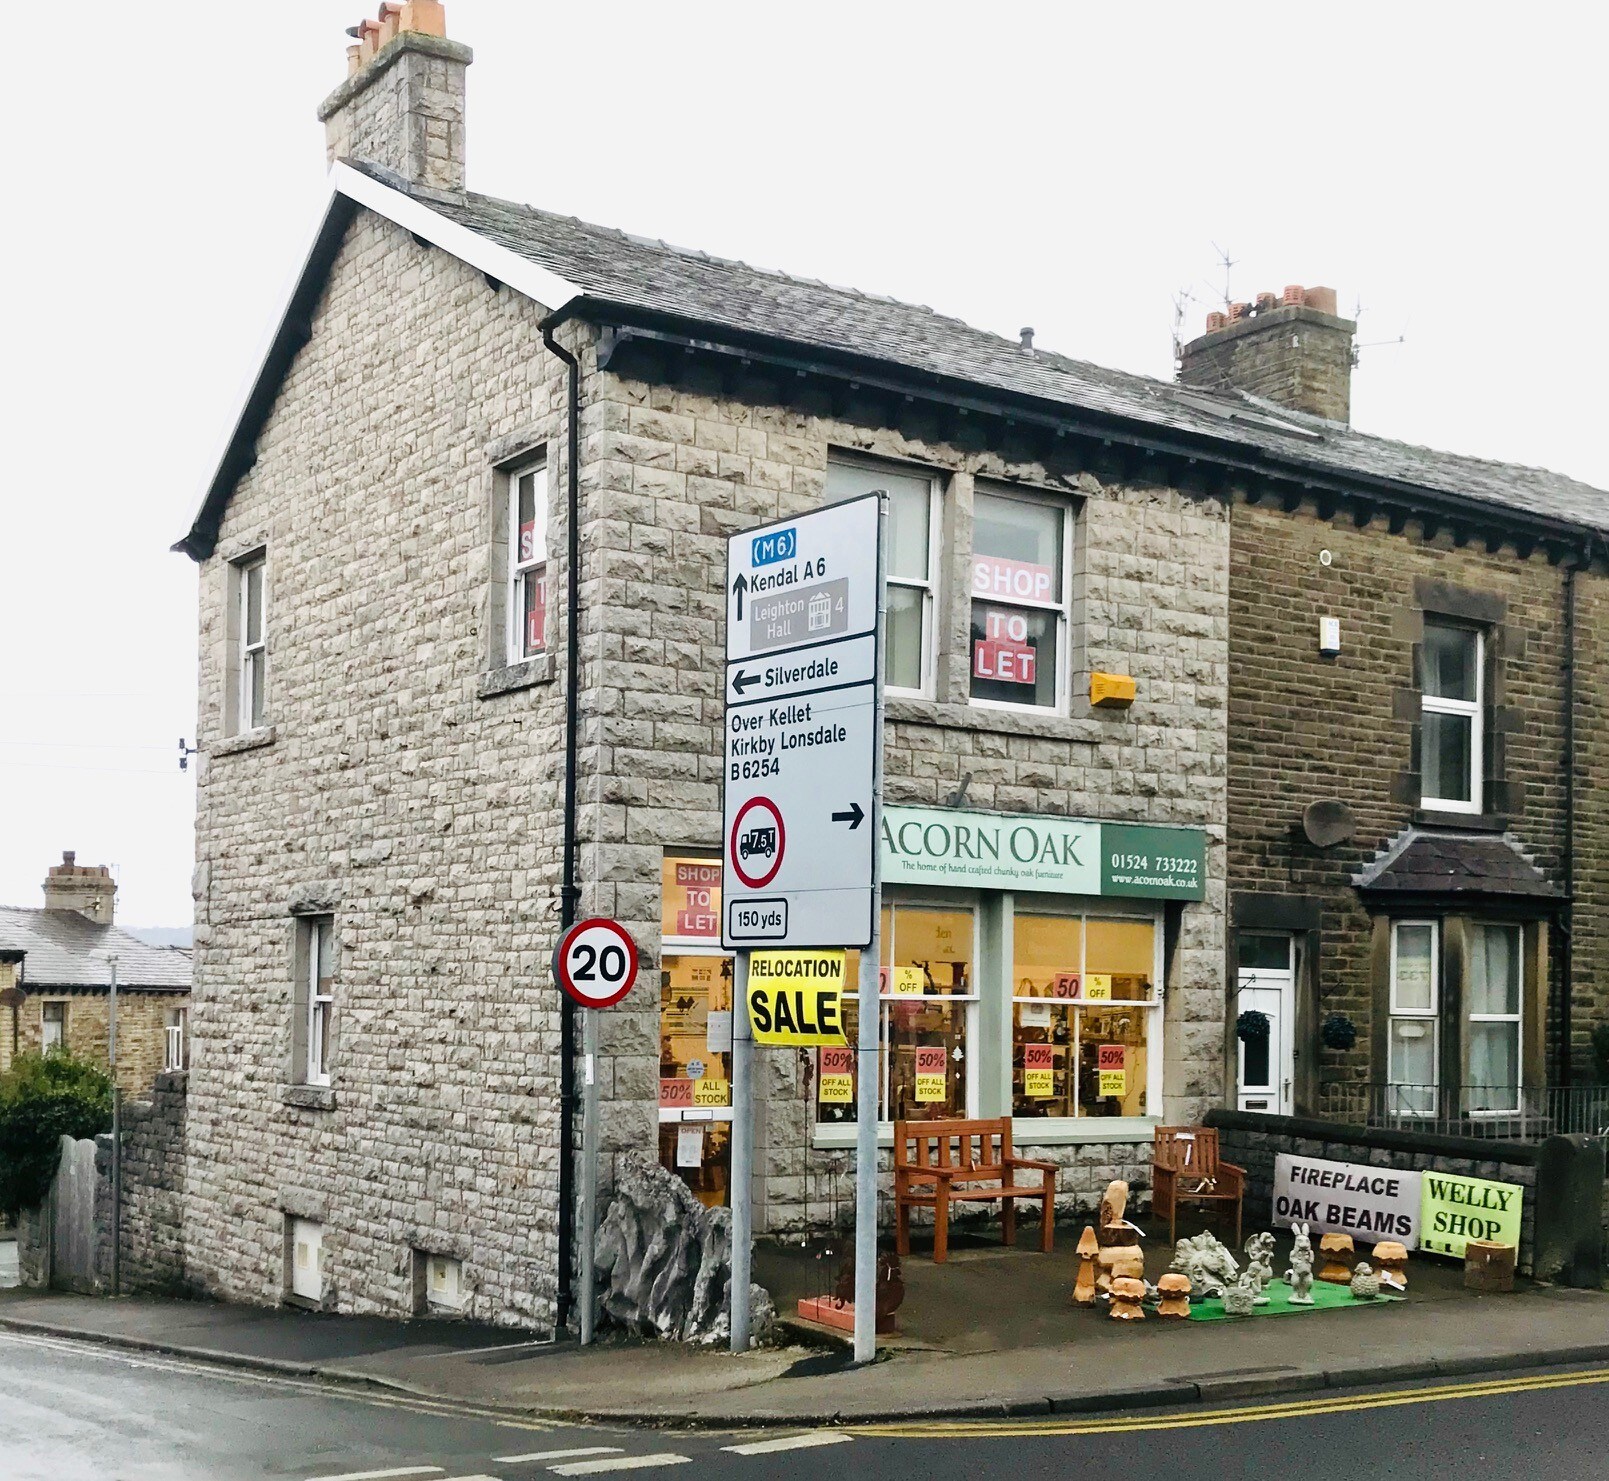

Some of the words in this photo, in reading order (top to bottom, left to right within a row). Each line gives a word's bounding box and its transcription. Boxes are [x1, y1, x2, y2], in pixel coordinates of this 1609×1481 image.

[753, 531, 795, 565] (M6)
[751, 565, 798, 593] Kendal
[974, 563, 1050, 597] SHOP
[755, 599, 804, 624] Leighton
[835, 596, 845, 613] 4
[767, 618, 791, 640] Hall
[989, 612, 1027, 641] TO
[765, 658, 838, 687] Silverdale
[978, 647, 1034, 680] LET
[731, 713, 763, 733] Over
[769, 703, 811, 727] Kellet
[731, 733, 775, 757] Kirkby
[782, 723, 846, 750] Lonsdale
[731, 757, 780, 781] B6254
[881, 815, 1000, 860] ACORN
[678, 866, 720, 882] SHOP
[902, 860, 915, 870] The
[917, 861, 937, 871] home
[939, 863, 947, 874] of
[949, 863, 966, 873] hand
[968, 865, 992, 876] crafted
[994, 866, 1019, 878] chunky
[1021, 868, 1034, 877] oak
[1112, 853, 1148, 870] 01524
[1156, 857, 1197, 874] 733222
[1112, 875, 1198, 888] www.acornoak.co.uk
[687, 891, 710, 906] TO
[684, 913, 717, 931] LET
[738, 911, 759, 928] 150
[761, 910, 781, 930] yds
[573, 945, 626, 982] 20
[752, 959, 841, 978] RELOCATION
[900, 983, 917, 992] OFF
[1057, 979, 1078, 998] 50
[1090, 989, 1105, 998] OFF
[751, 990, 841, 1036] SALE
[919, 1053, 945, 1067] 50%
[1027, 1050, 1051, 1063] 50%
[1101, 1051, 1124, 1064] 50%
[661, 1084, 692, 1101] 50%
[702, 1082, 720, 1091] ALL
[824, 1088, 848, 1096] STOCK
[1102, 1082, 1122, 1090] STOCK
[695, 1094, 727, 1104] STOCK
[1290, 1166, 1400, 1198] FIREPLACE
[1429, 1178, 1513, 1212] WELLY
[1276, 1196, 1319, 1222] OAK
[1326, 1204, 1413, 1236] BEAMS
[1433, 1211, 1502, 1241] SHOP
